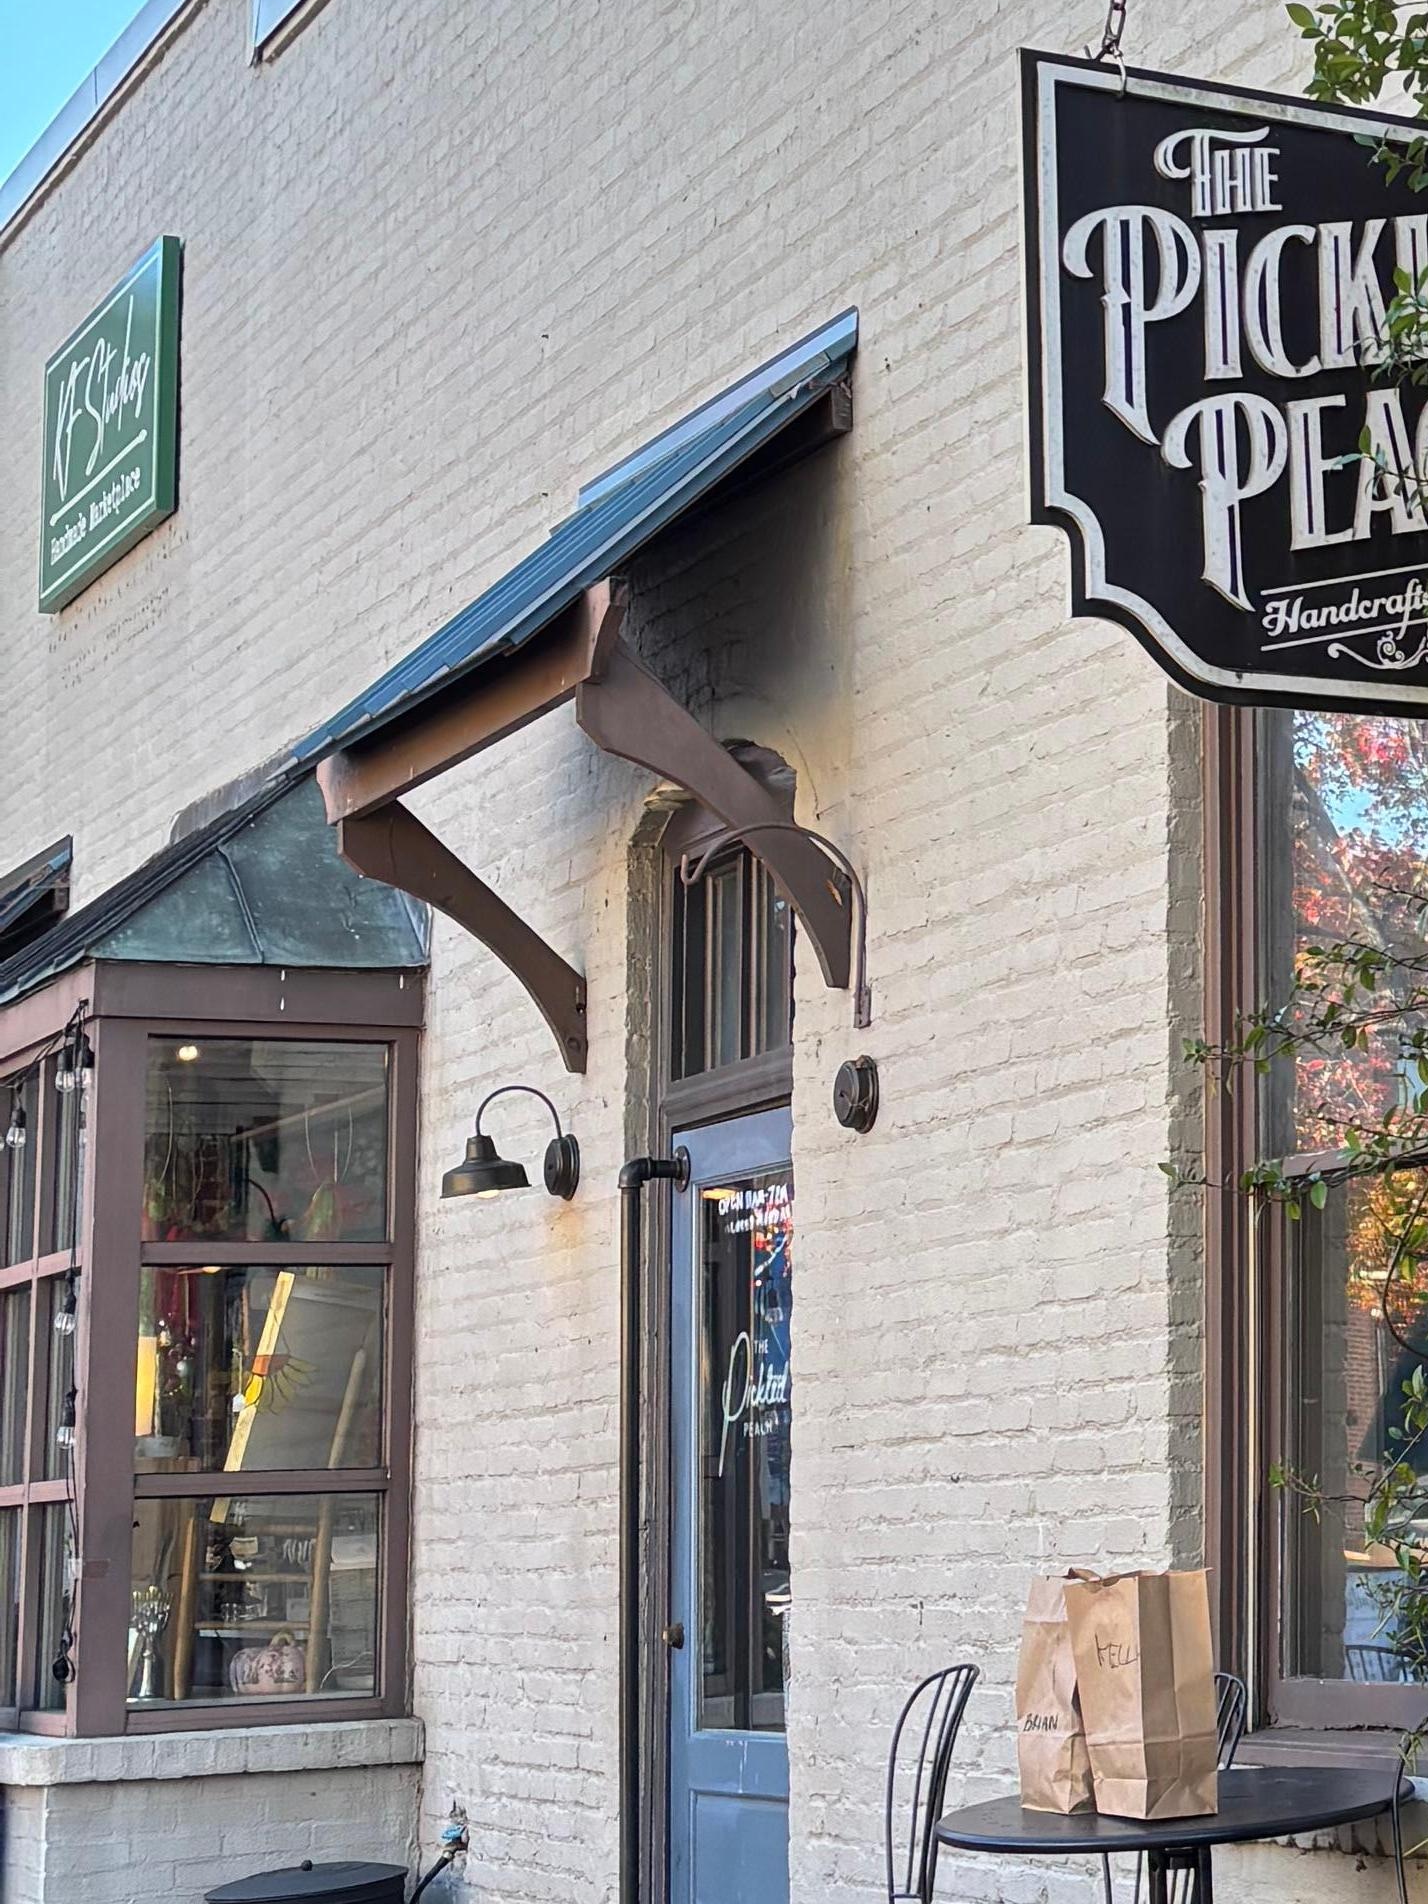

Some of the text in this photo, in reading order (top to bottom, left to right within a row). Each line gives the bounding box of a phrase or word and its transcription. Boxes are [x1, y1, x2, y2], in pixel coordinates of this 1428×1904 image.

[1154, 126, 1283, 217] THE
[89, 467, 140, 531] Marketplace
[754, 1338, 769, 1355] THE
[718, 1331, 789, 1477] Pickled
[743, 1418, 773, 1438] PEACH
[1023, 1712, 1059, 1732] BRIAN
